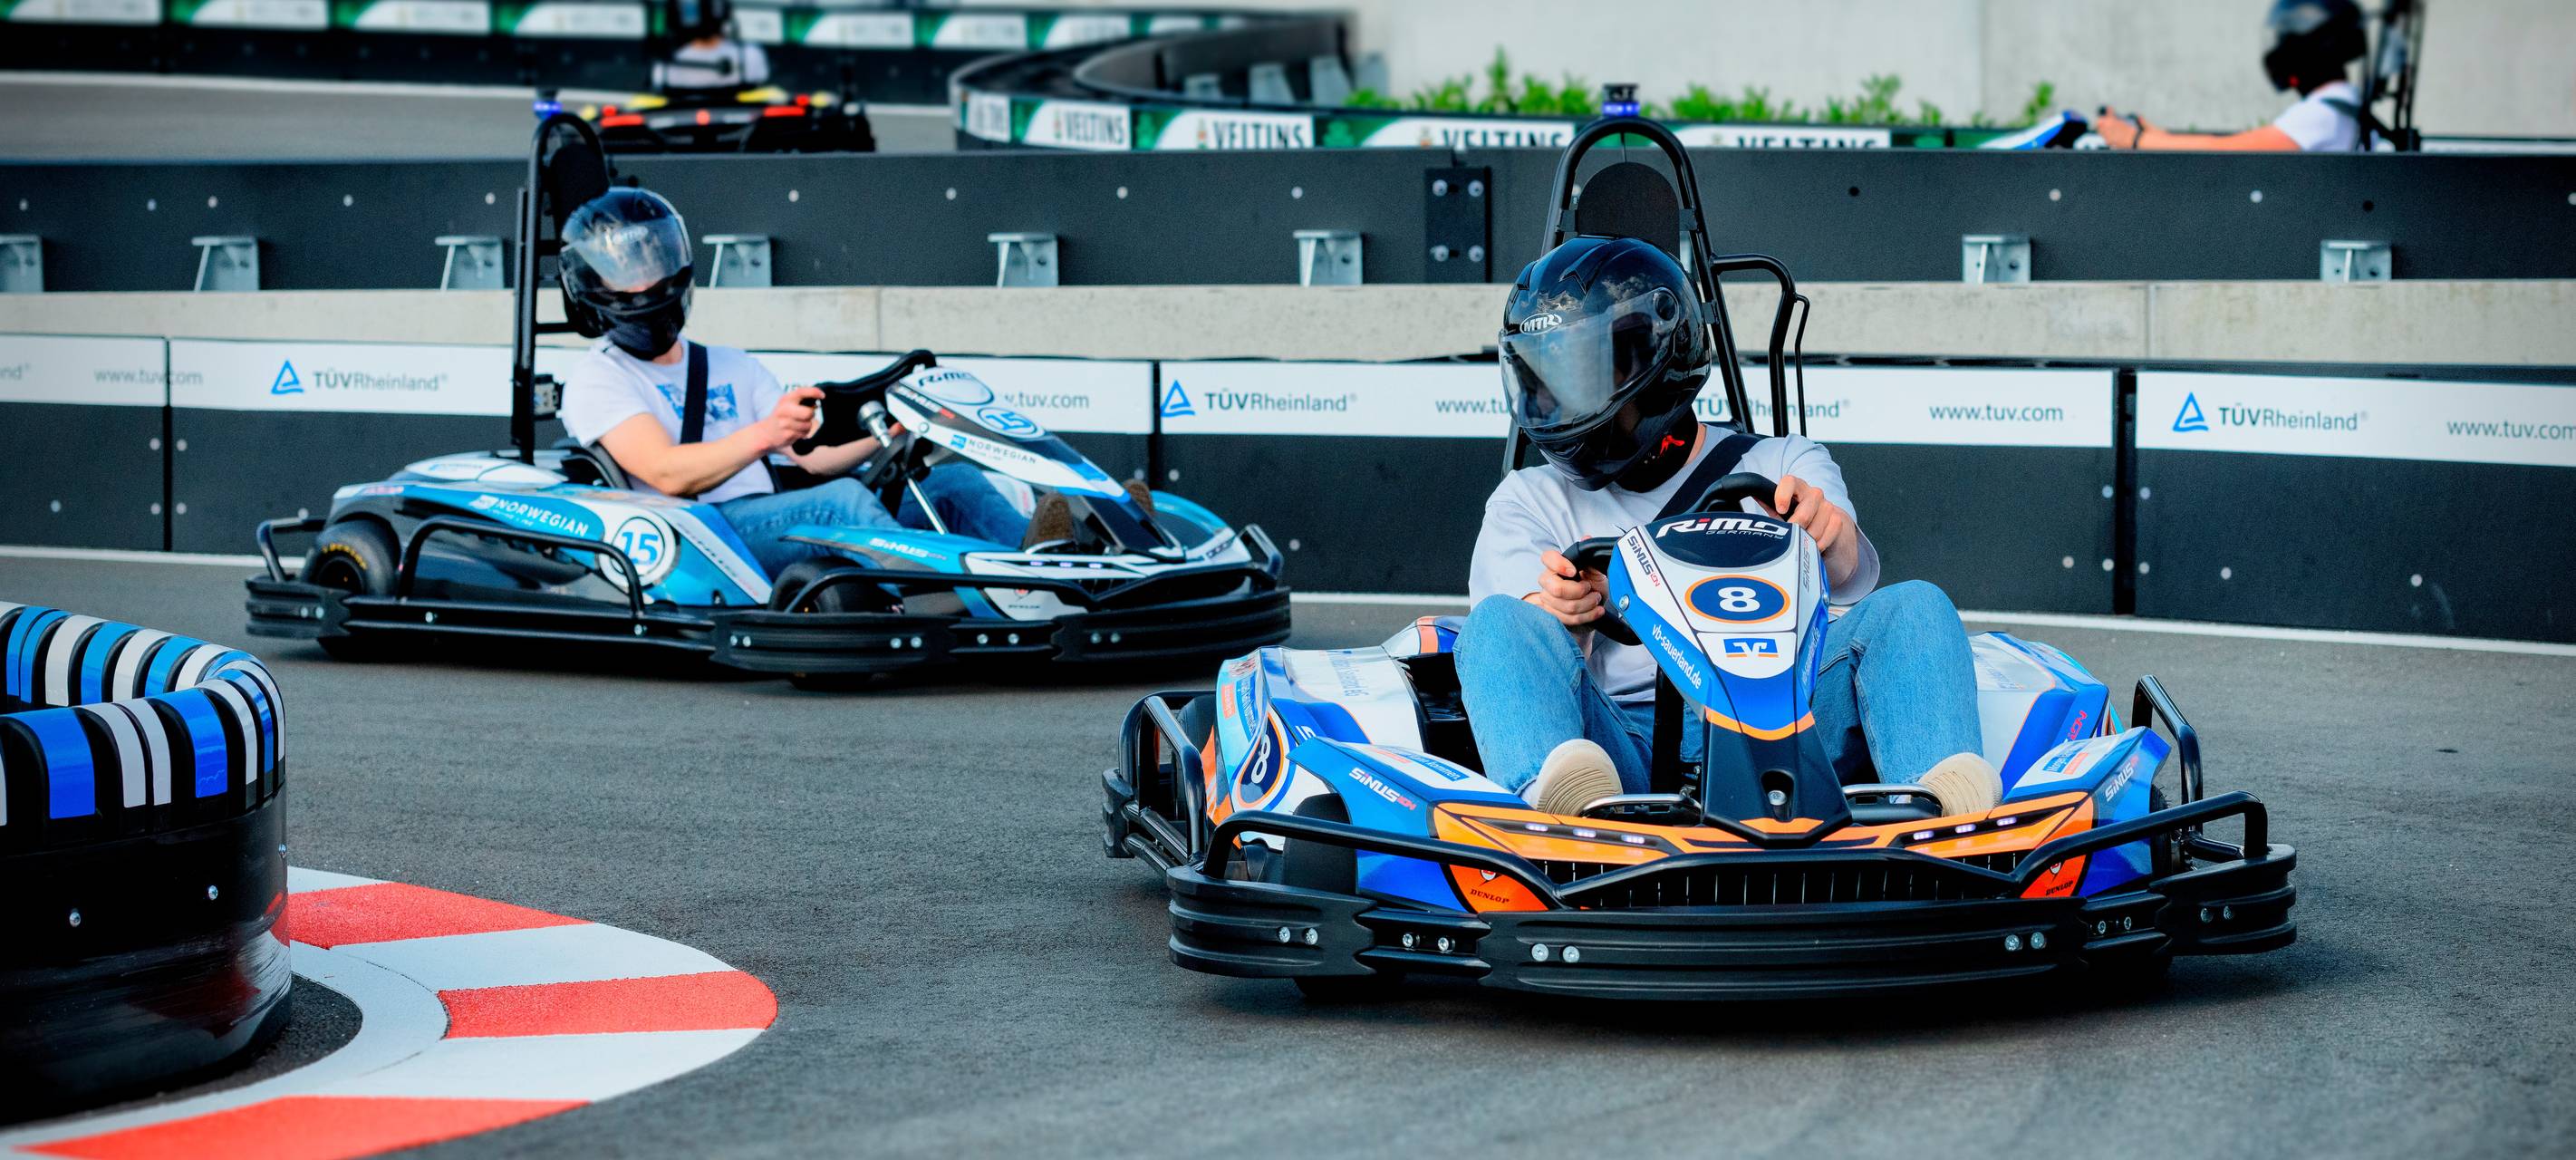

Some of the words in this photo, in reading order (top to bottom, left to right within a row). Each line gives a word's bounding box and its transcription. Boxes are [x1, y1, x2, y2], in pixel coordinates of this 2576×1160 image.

[1065, 107, 1124, 146] VELTINS
[985, 411, 1032, 430] 15
[1929, 403, 2064, 421] www.tuv.com
[497, 498, 589, 537] NORWEGIAN
[621, 531, 659, 565] 15
[1718, 586, 1761, 613] 8
[1652, 624, 1702, 690] vb-sauerland.de
[1250, 733, 1271, 785] 8
[1470, 888, 1510, 904] DUNLOP
